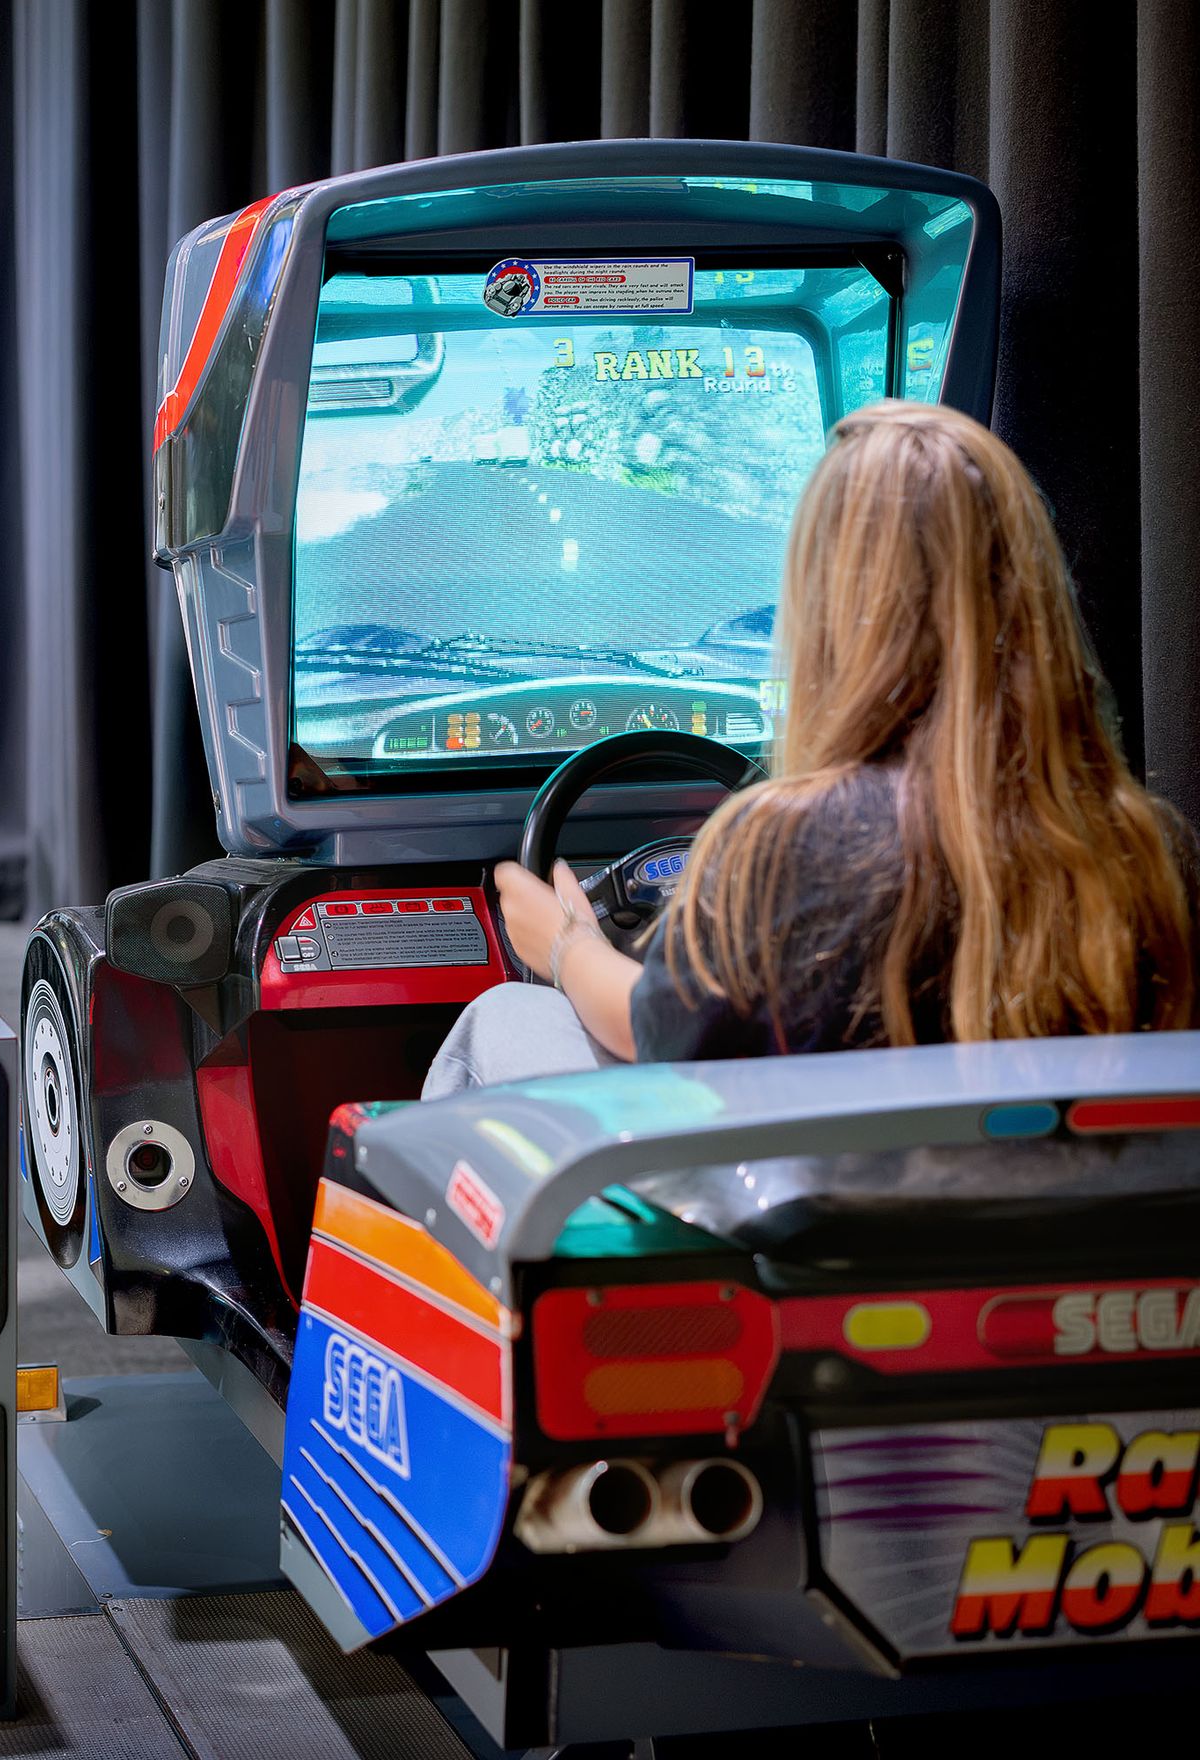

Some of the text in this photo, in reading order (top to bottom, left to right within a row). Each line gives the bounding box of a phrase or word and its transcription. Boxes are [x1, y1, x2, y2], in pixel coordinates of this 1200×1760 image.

[553, 337, 575, 368] 3
[594, 348, 703, 382] RANK
[703, 376, 796, 393] Round 6
[323, 1332, 411, 1481] SEGA
